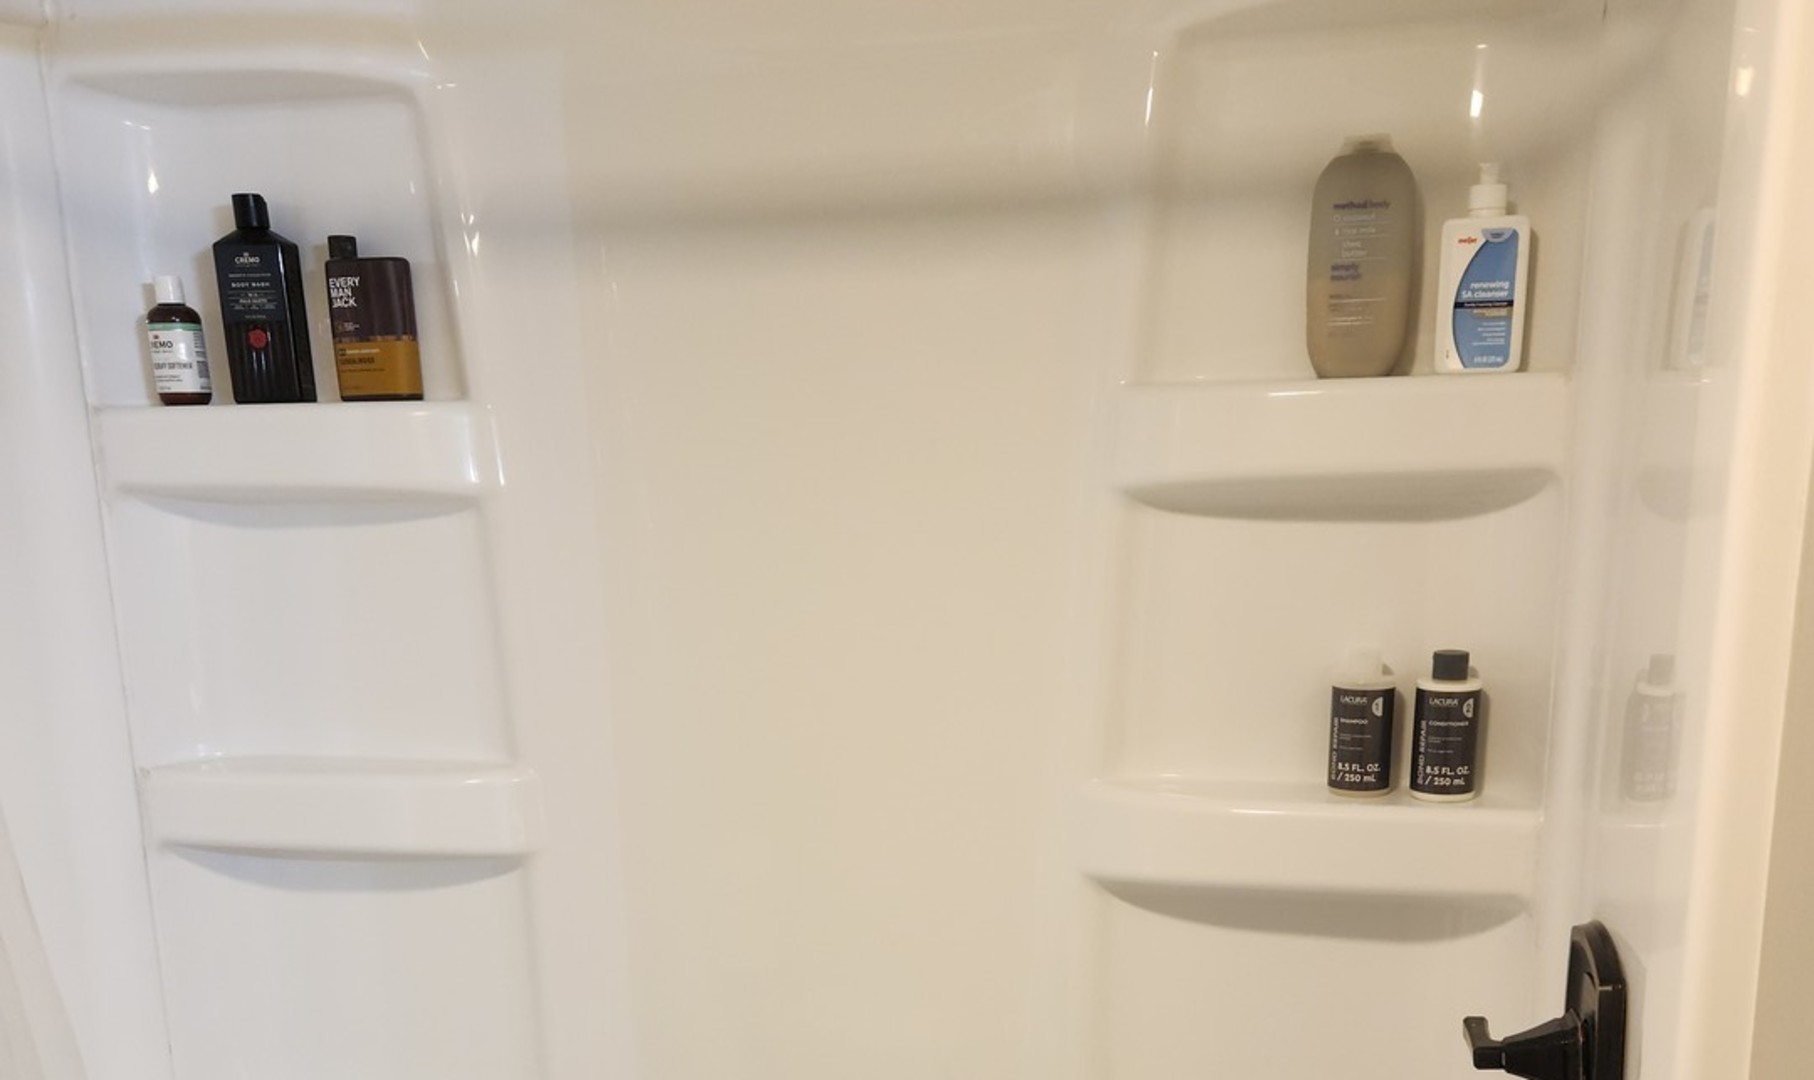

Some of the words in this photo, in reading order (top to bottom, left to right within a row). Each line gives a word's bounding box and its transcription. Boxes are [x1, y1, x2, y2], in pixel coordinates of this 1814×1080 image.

[234, 256, 261, 264] CREMO
[329, 276, 360, 288] EVERY
[1469, 280, 1511, 290] renewing
[330, 287, 353, 298] MAN
[1461, 290, 1474, 299] SA
[1474, 289, 1509, 298] cleanser
[332, 297, 358, 308] JACK
[1340, 695, 1368, 705] LACURA
[1428, 698, 1460, 707] LACURA
[1340, 717, 1369, 725] SHAMPOO
[1337, 761, 1350, 771] 8.5
[1351, 763, 1365, 772] FL.
[1366, 763, 1382, 772] OZ.
[1425, 765, 1440, 775] 8.5
[1441, 766, 1455, 775] FL.
[1456, 765, 1471, 775] OZ.
[1344, 773, 1362, 783] 250
[1433, 777, 1452, 786] 250
